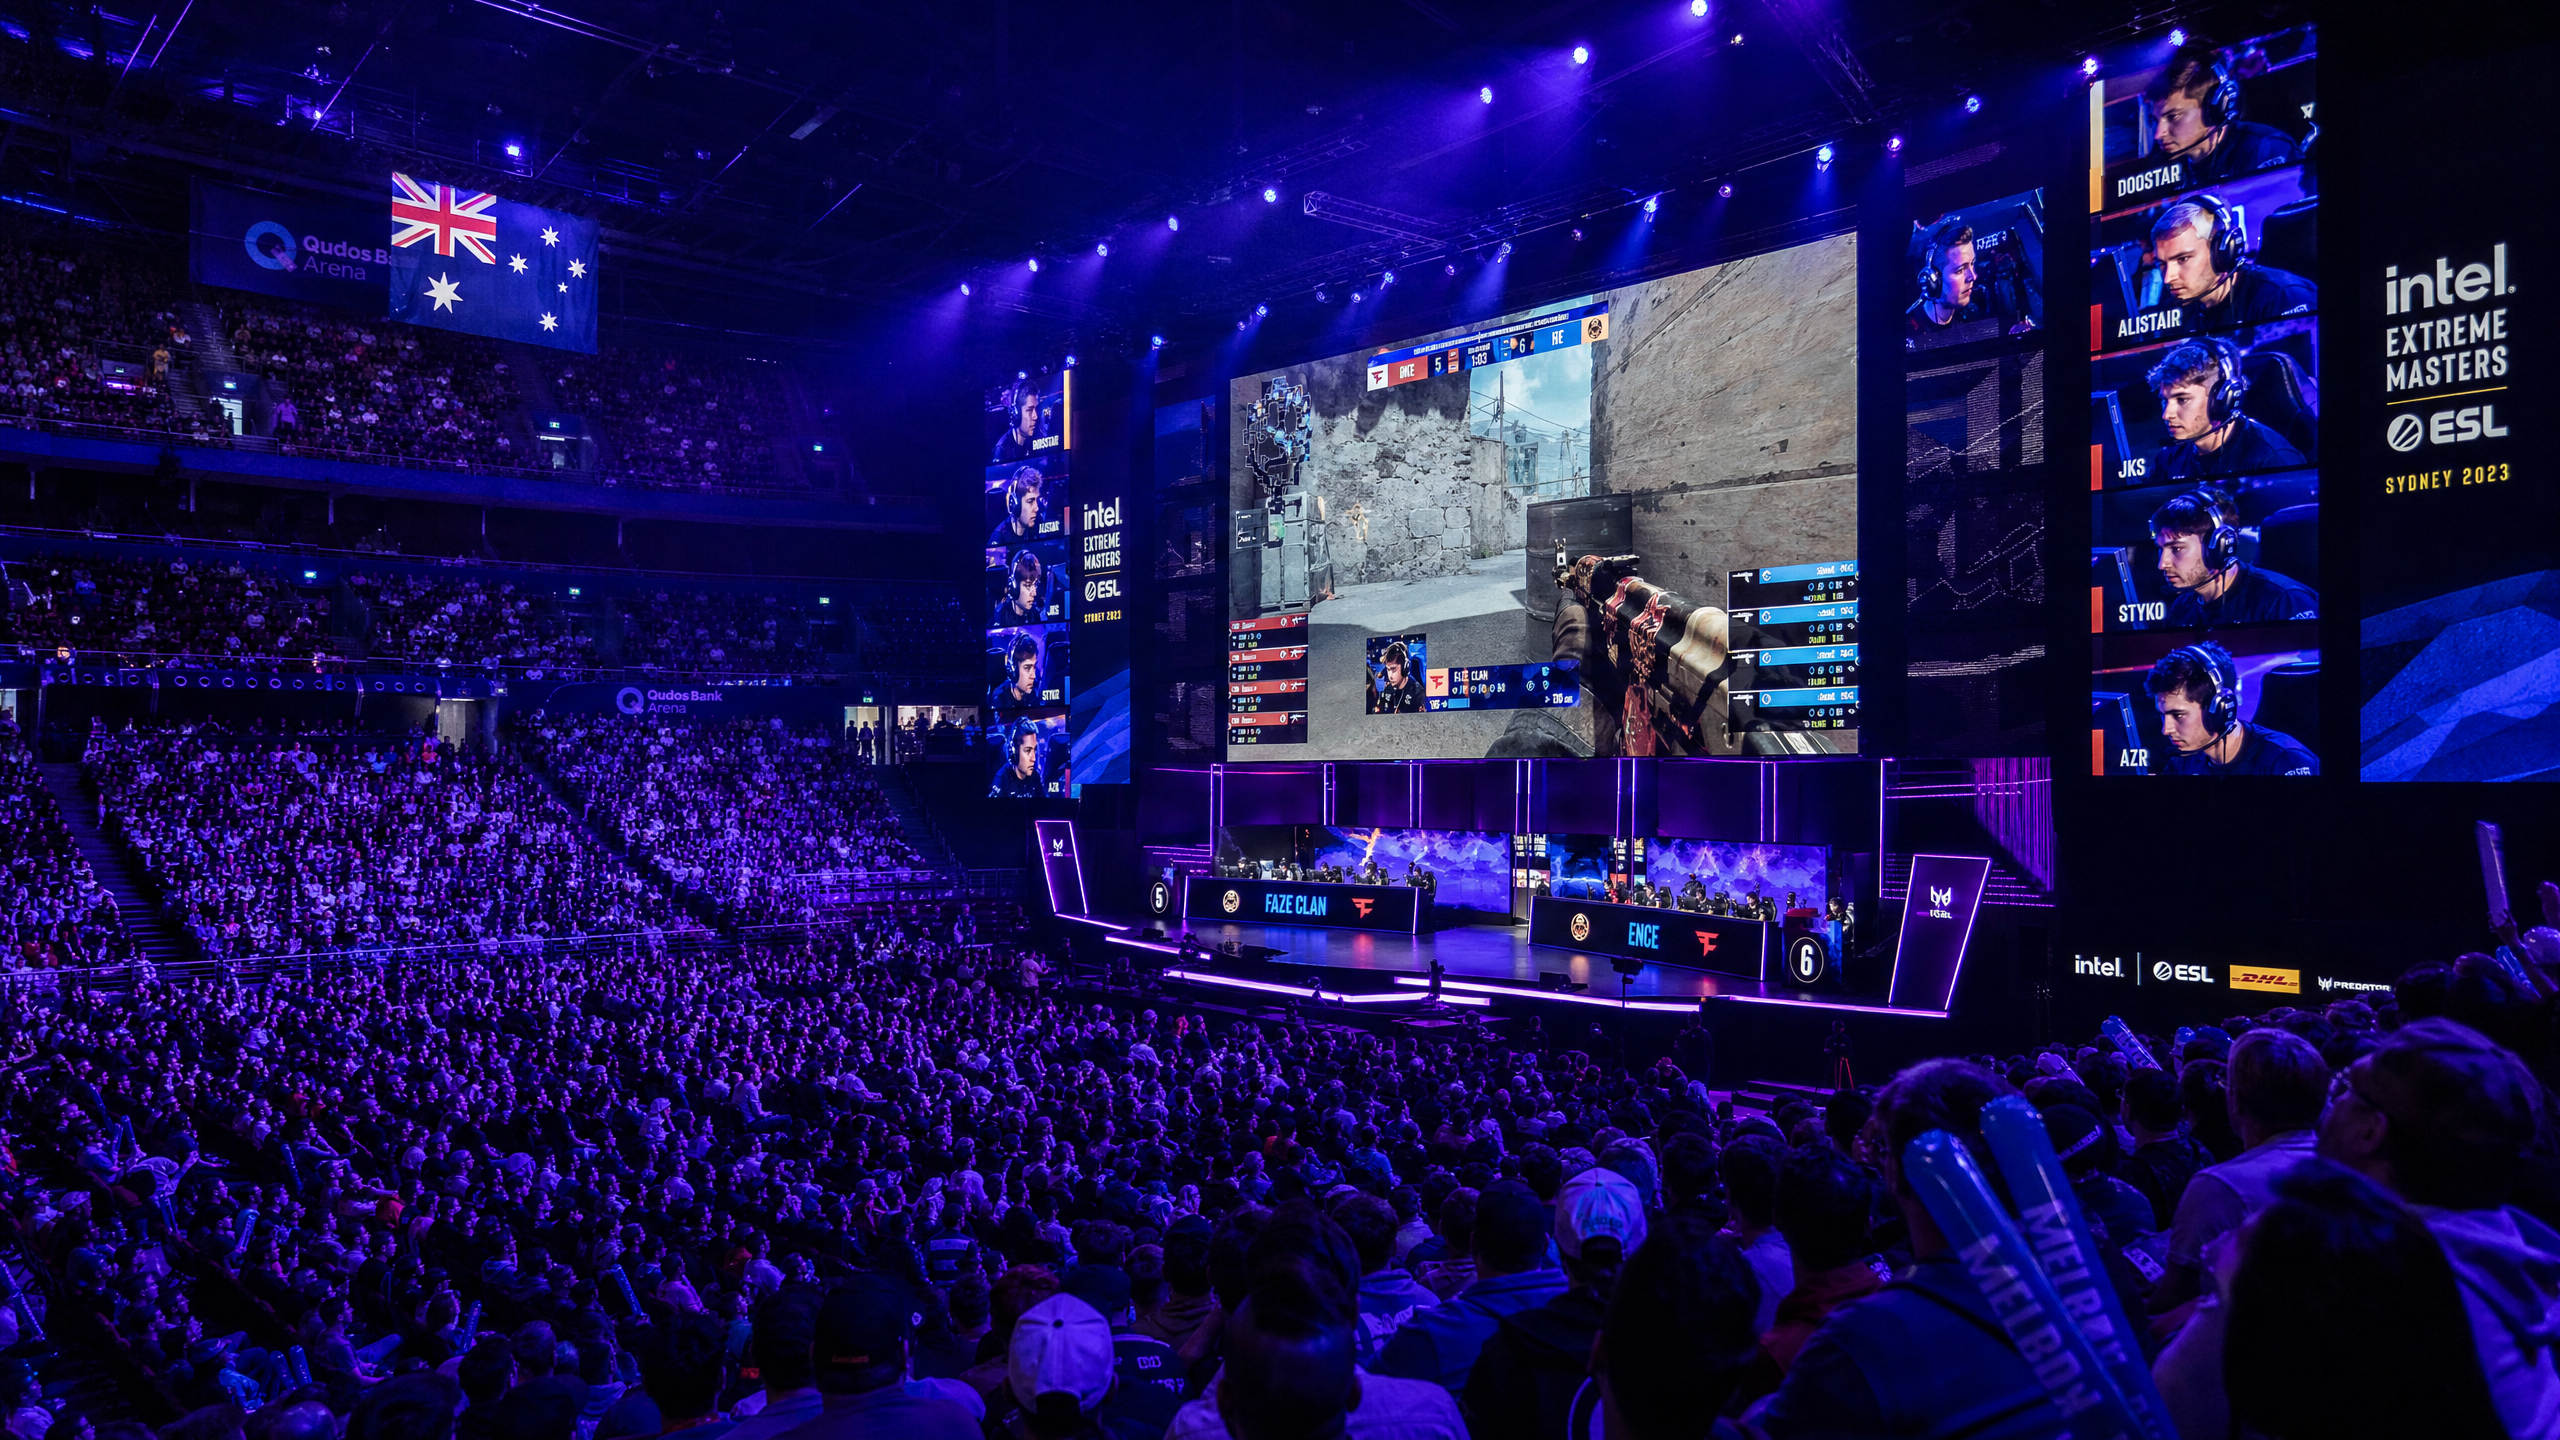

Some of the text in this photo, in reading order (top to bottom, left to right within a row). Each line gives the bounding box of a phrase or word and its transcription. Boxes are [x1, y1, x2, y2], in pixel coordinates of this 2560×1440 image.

[2117, 163, 2181, 197] DOOSTAR
[303, 235, 372, 262] Qudos
[303, 255, 366, 281] Arena
[2117, 308, 2181, 338] ALISTAIR
[2386, 308, 2508, 358] EXTREME
[1519, 337, 1526, 353] 6
[1434, 356, 1442, 373] 5
[2386, 345, 2508, 392] MASTERS
[2430, 404, 2509, 445] ESL
[2117, 457, 2146, 479] JKS
[2386, 463, 2510, 494] SYDNEY 2023
[1084, 531, 1121, 553] EXTREME
[1084, 550, 1121, 571] MASTERS
[1097, 578, 1122, 599] ESL
[2118, 601, 2165, 623] STYKO
[647, 689, 723, 702] Qudos Bank
[647, 702, 687, 714] Arena
[2120, 748, 2148, 767] AZR
[1155, 887, 1164, 909] 5
[1265, 893, 1327, 916] FAZE CLAN
[1628, 921, 1661, 950] ENCE
[1800, 943, 1814, 977] 6
[2174, 964, 2215, 984] ESL
[2240, 973, 2288, 986] DHL
[2333, 981, 2392, 992] PREDATOR
